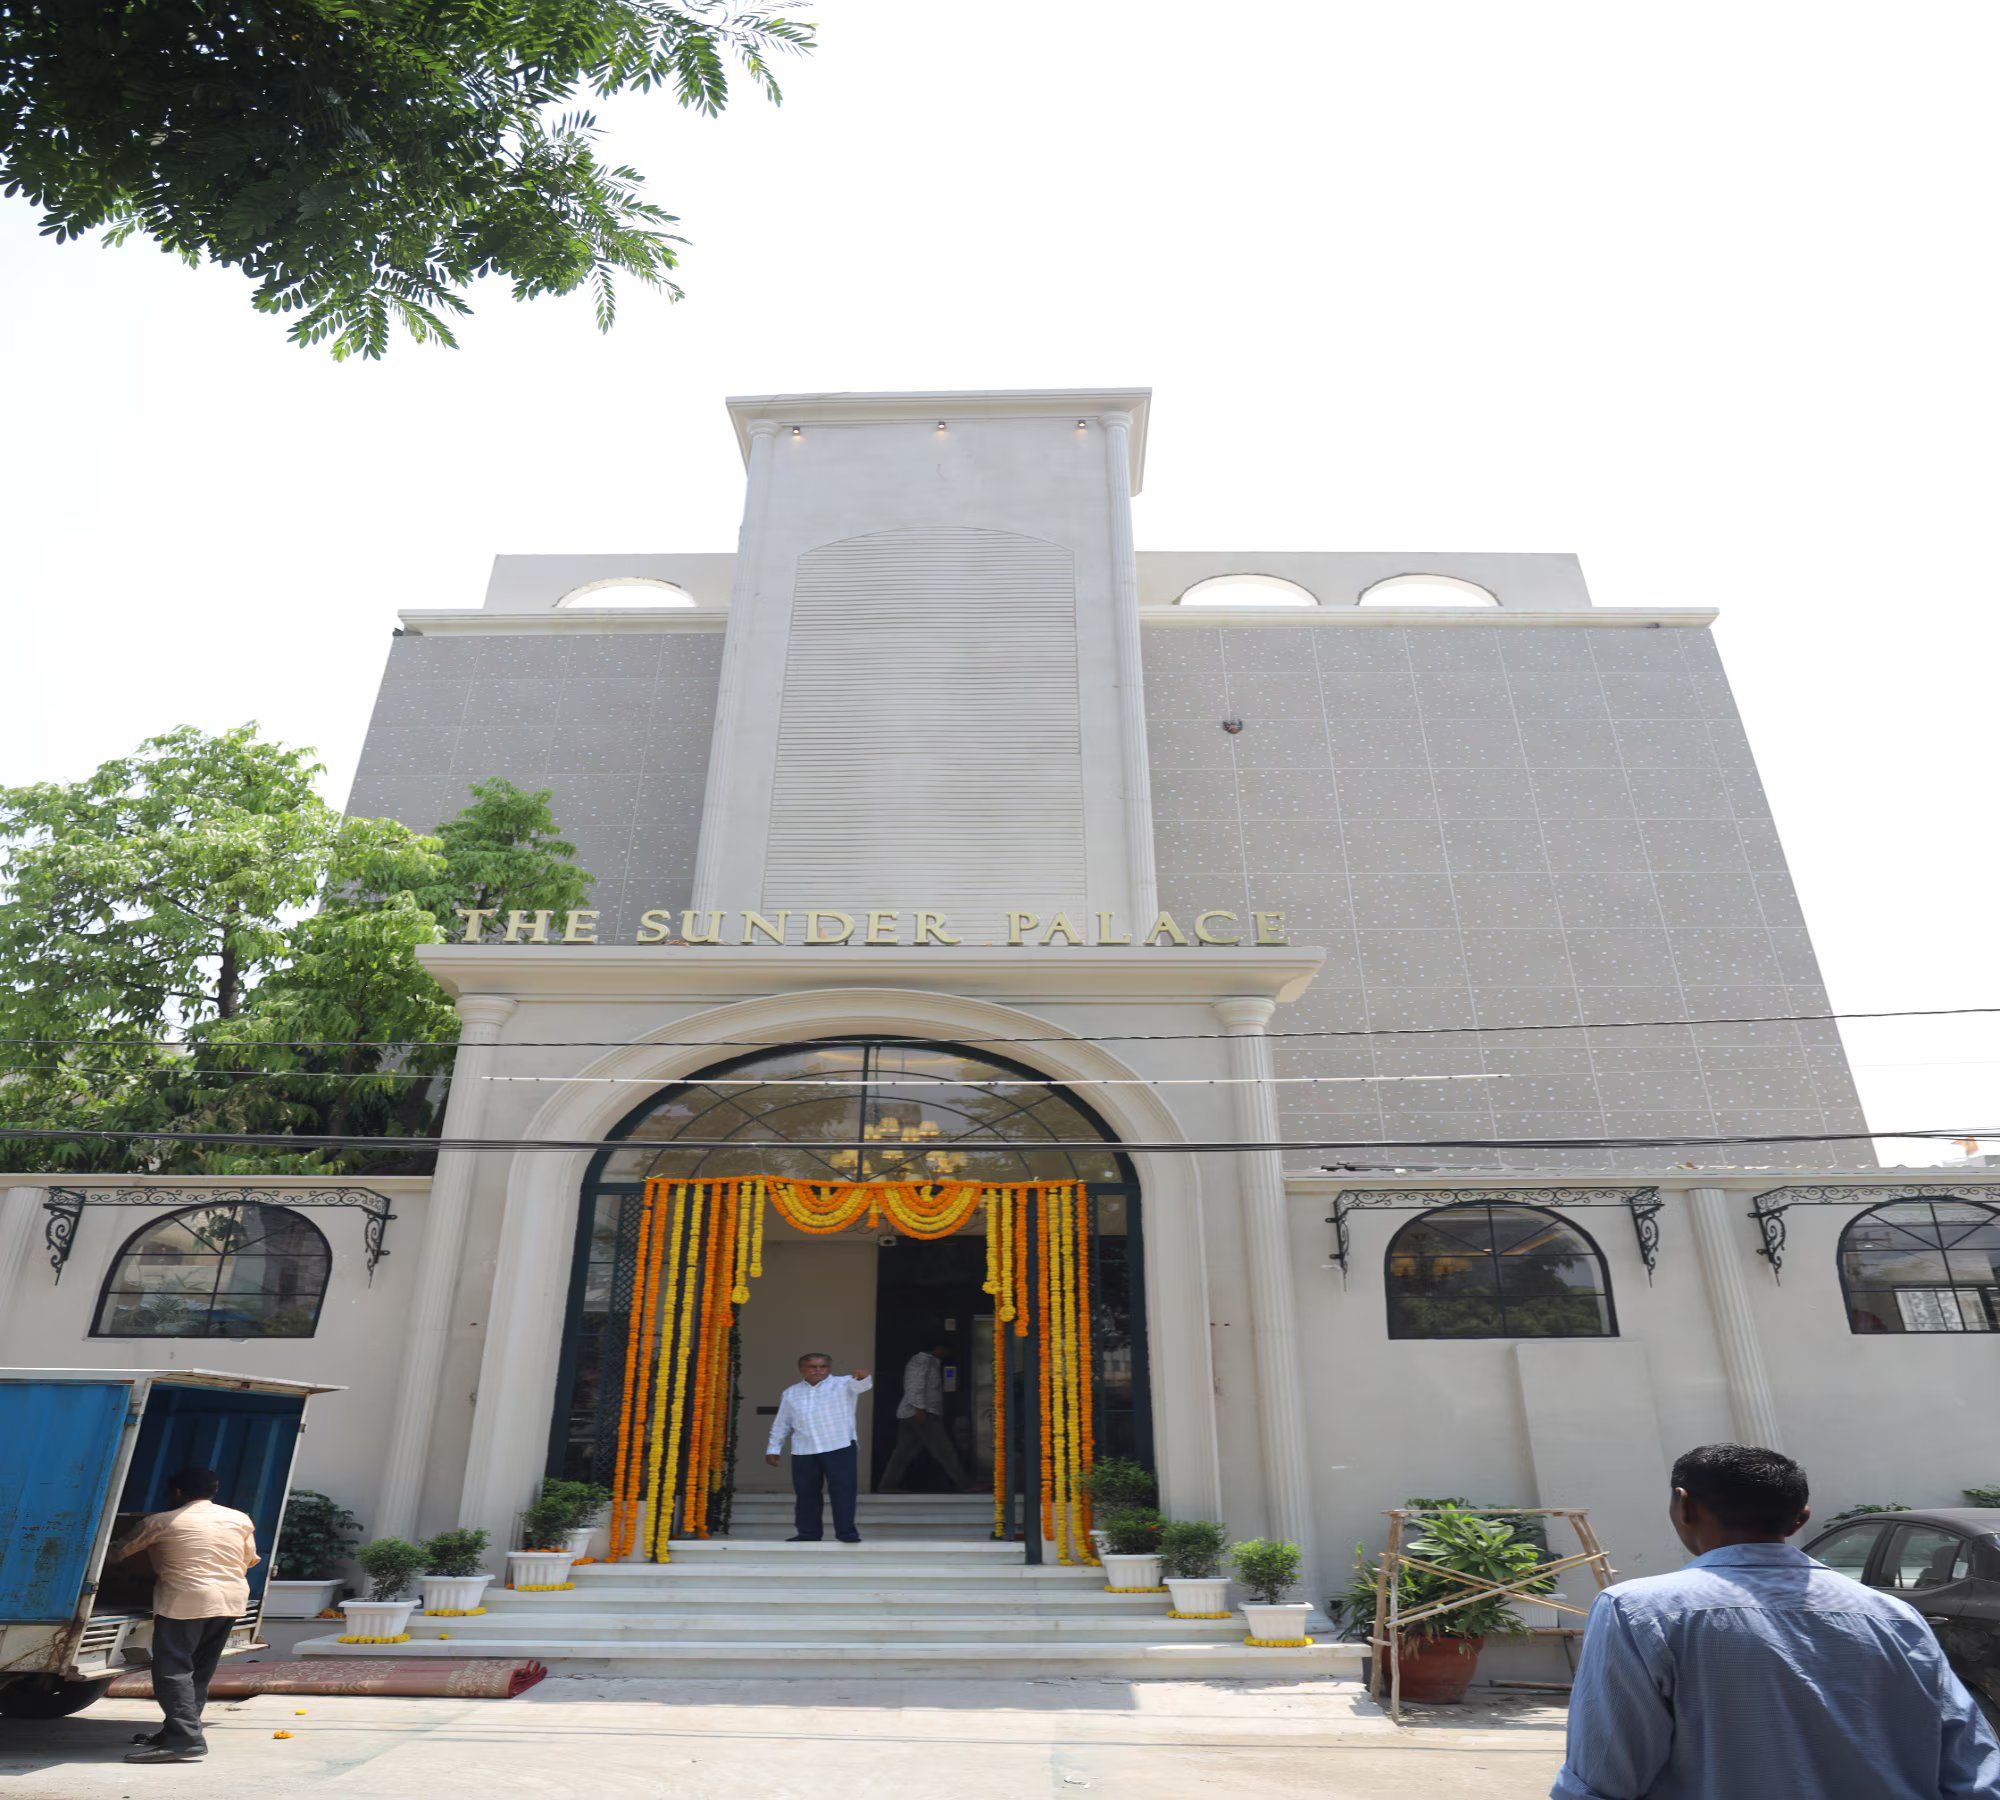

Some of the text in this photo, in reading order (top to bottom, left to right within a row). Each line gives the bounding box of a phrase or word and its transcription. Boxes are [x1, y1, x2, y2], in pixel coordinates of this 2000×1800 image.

[456, 909, 1291, 946] THE SUNDER PALACE
